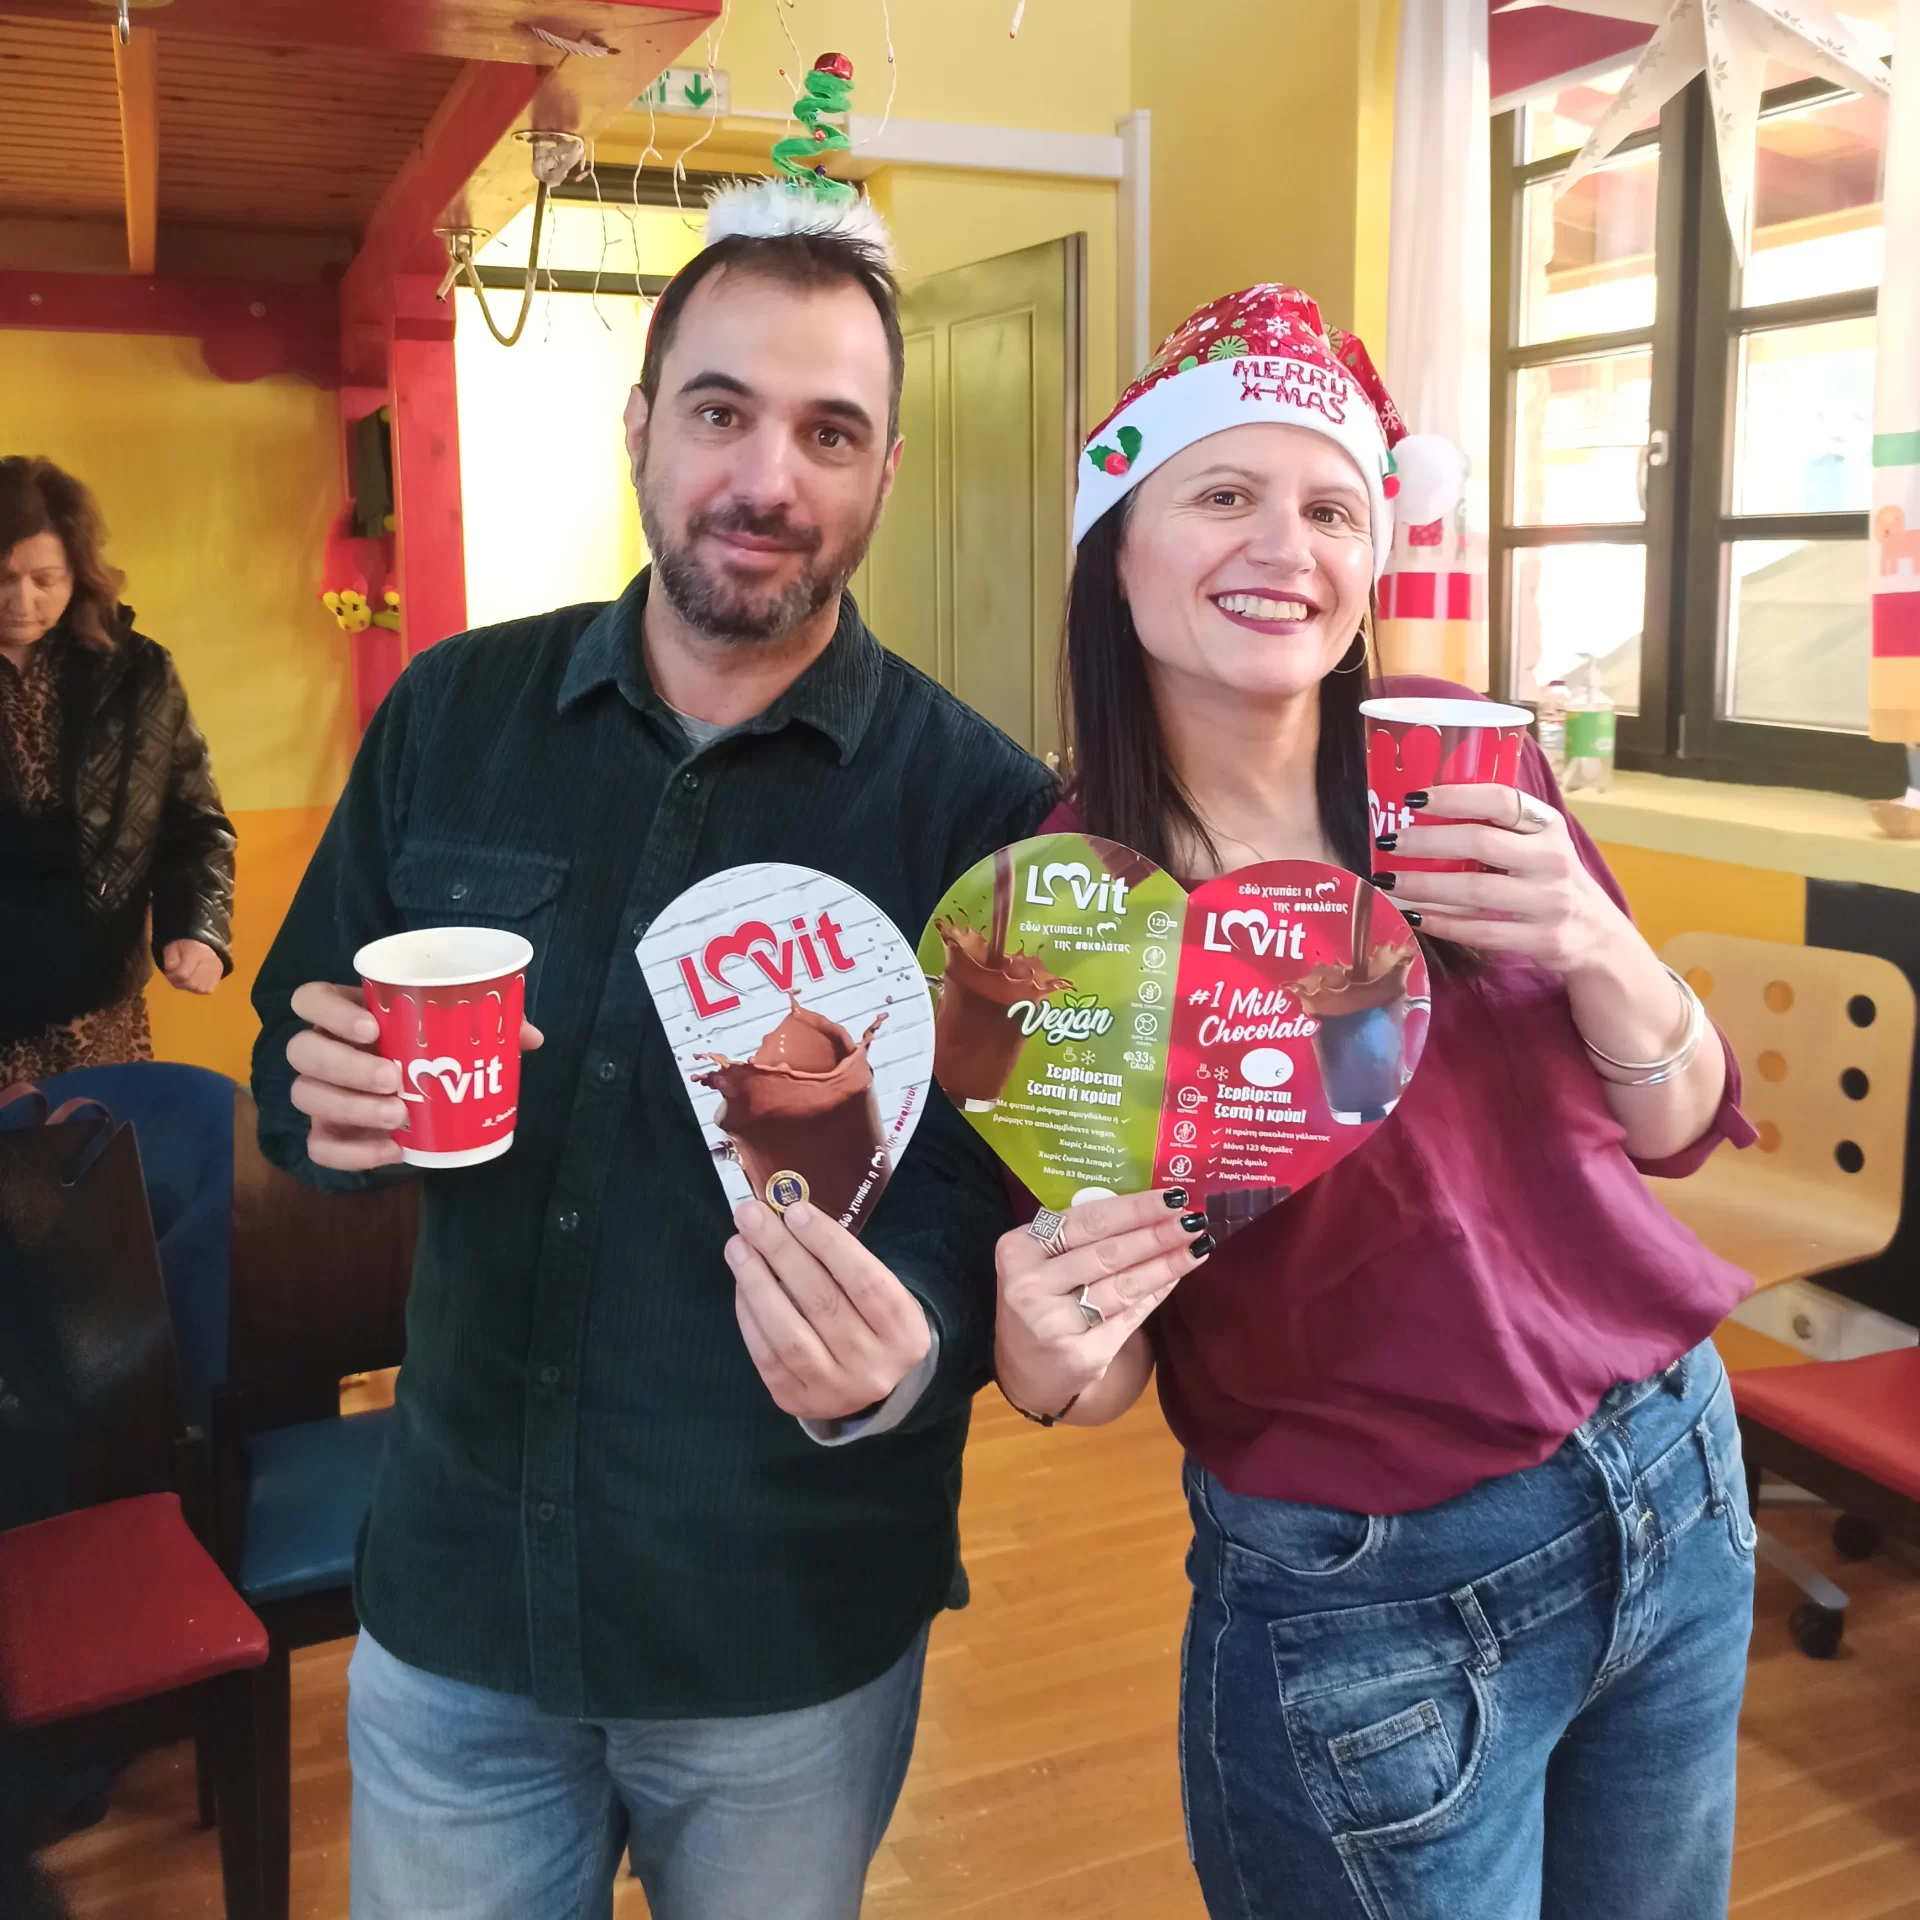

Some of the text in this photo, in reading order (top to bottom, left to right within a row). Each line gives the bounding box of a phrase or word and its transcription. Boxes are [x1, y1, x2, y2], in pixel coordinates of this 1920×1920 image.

[1233, 360, 1348, 403] MERRY
[1240, 377, 1347, 425] X-MAS
[1238, 884, 1312, 899] εδώ χτυπάει η
[1273, 900, 1349, 915] της σοκολάτας
[1020, 920, 1093, 937] εδώ χτυπάει η
[1152, 918, 1166, 928] 123
[1053, 939, 1131, 955] της σοκολάτας
[1188, 980, 1292, 1020] #1 Milk
[1007, 999, 1114, 1044] Vegan
[1198, 1012, 1322, 1047] Chocolate
[1046, 1063, 1123, 1088] Σερβίρεται
[1027, 1079, 1122, 1107] ζεστή ή κρύα!
[1183, 1093, 1197, 1102] 123
[1217, 1083, 1292, 1104] Σερβίρεται
[1214, 1102, 1307, 1124] ζεστή ή κρύα!
[1245, 1143, 1259, 1152] 123
[838, 1213, 854, 1228] δώ
[848, 1180, 874, 1215] χτυπάει
